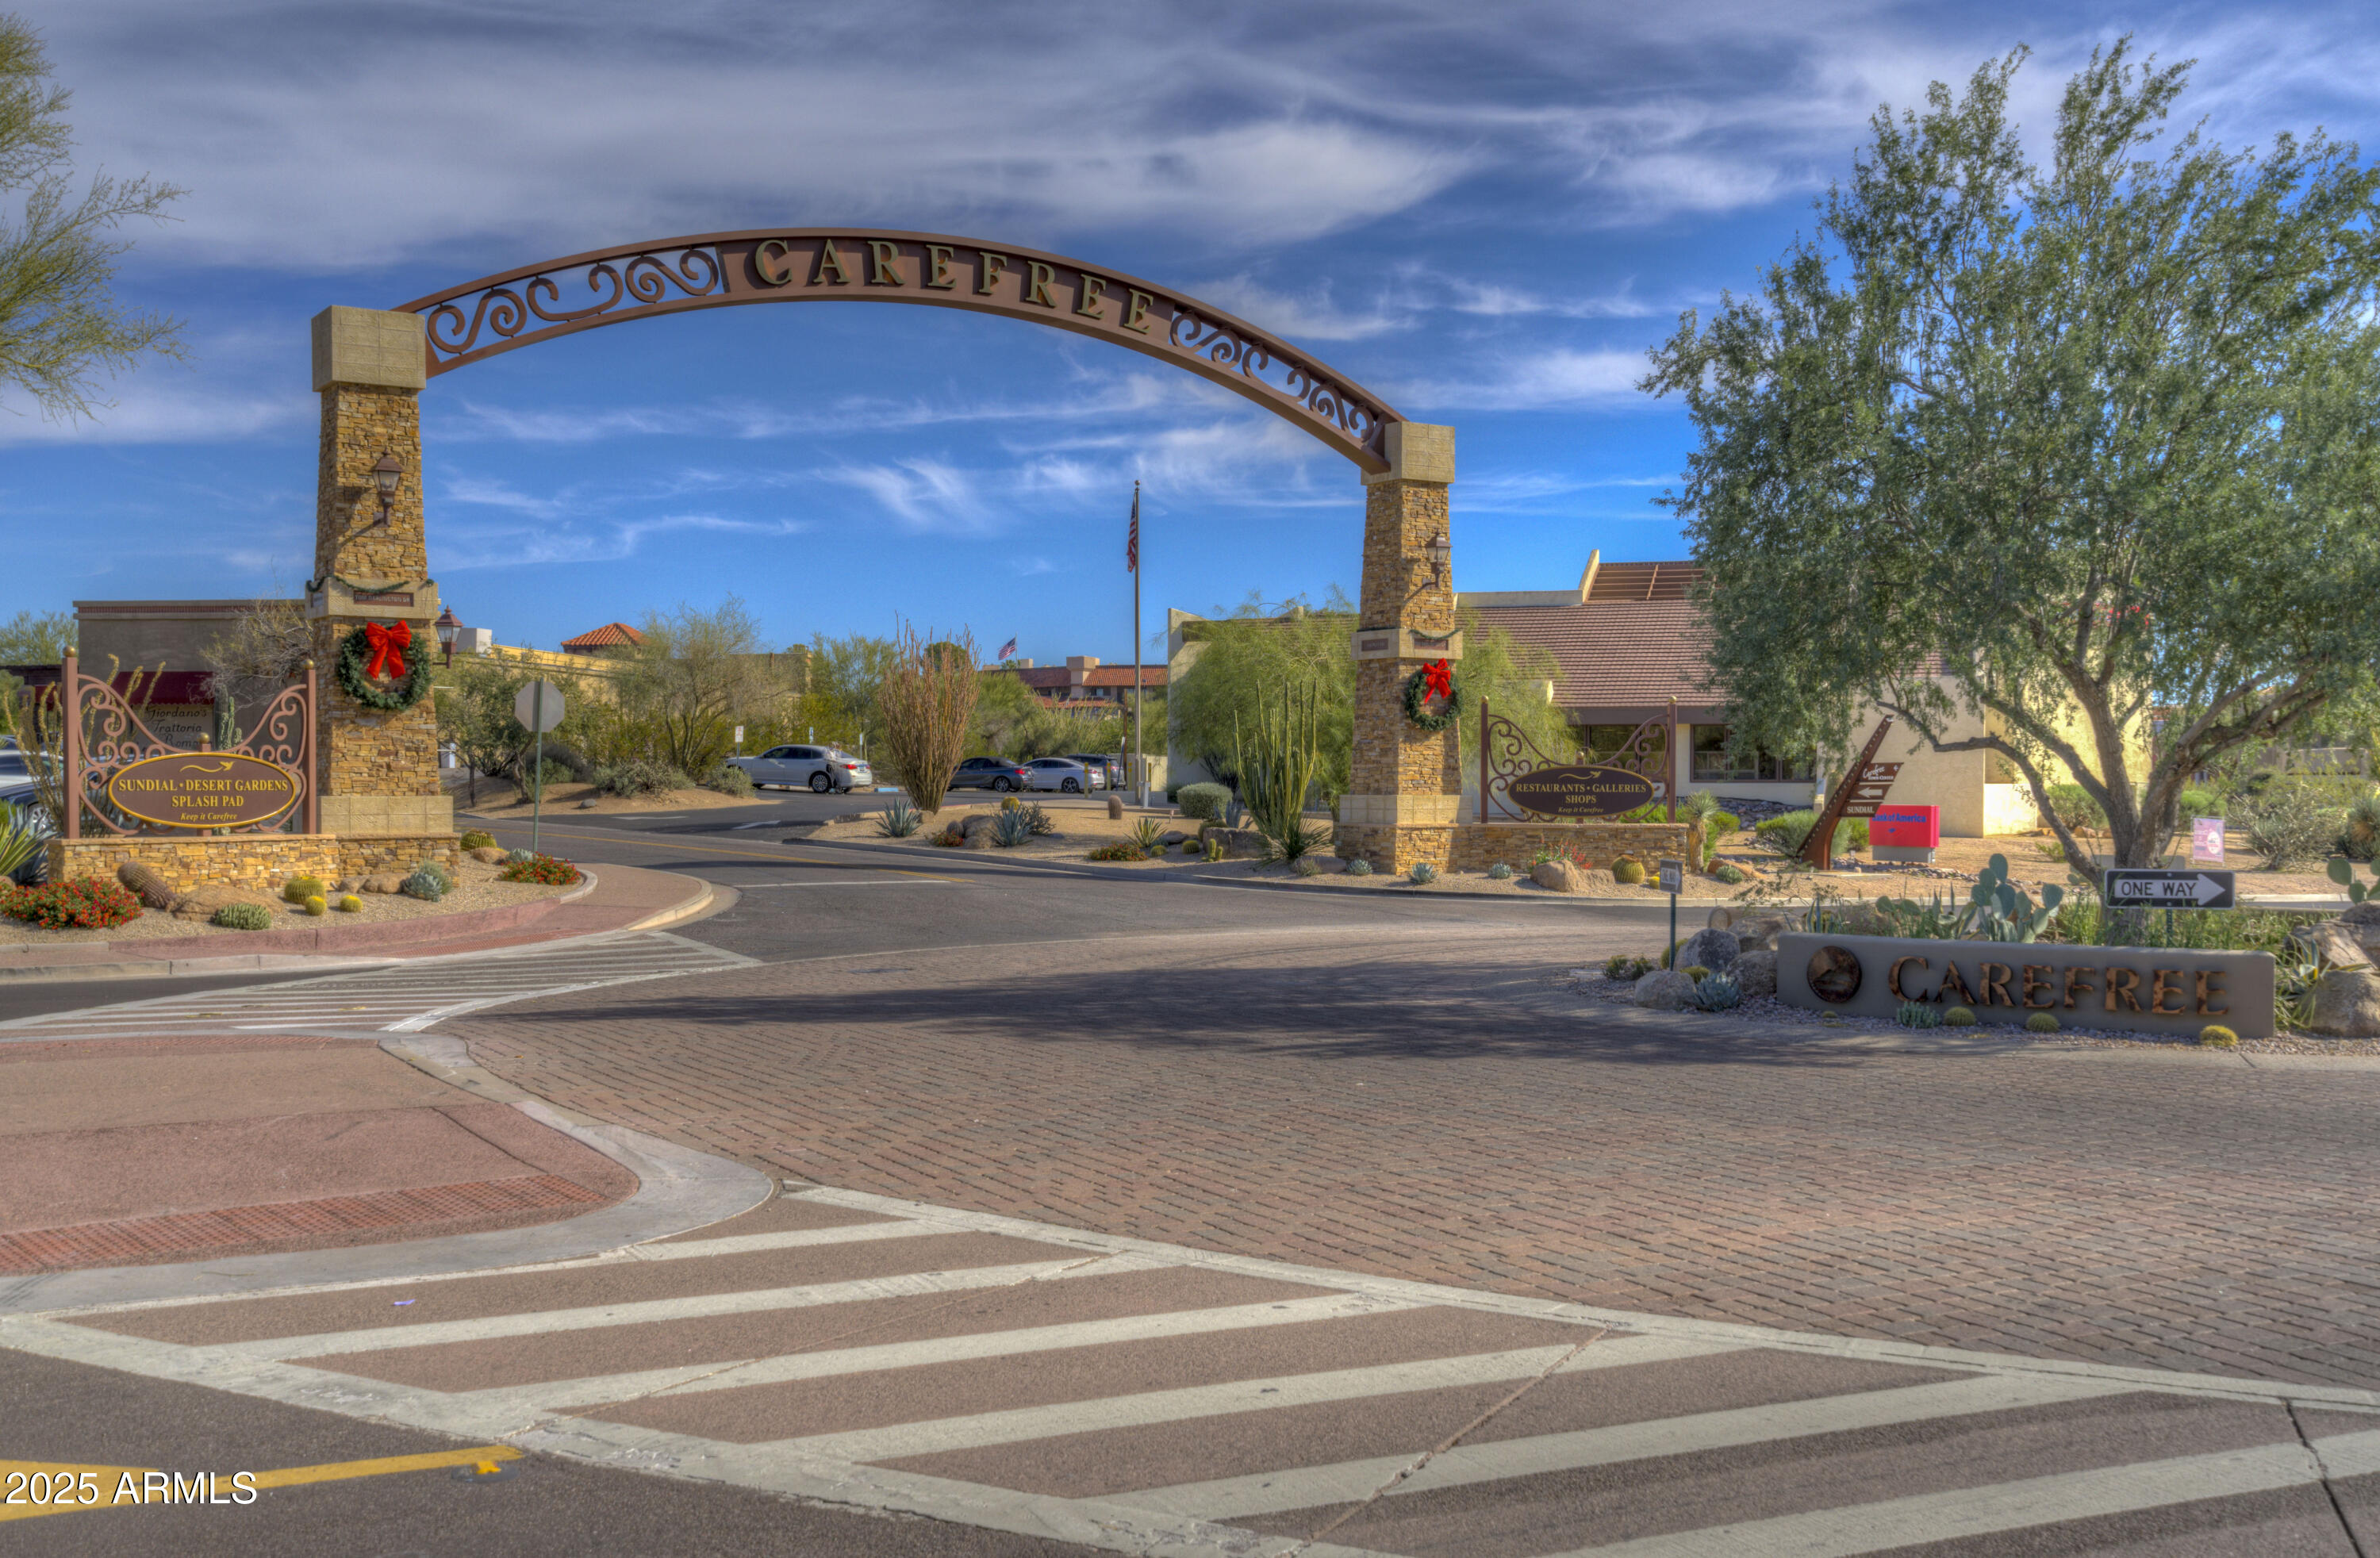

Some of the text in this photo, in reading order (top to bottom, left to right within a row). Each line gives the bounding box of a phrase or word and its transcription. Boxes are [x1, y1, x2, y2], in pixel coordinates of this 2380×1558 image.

[754, 239, 1154, 334] CAREFREE
[152, 719, 202, 733] Trattoria
[1862, 764, 1886, 778] Carefree
[119, 780, 288, 791] SUNDIAL DESERT GARDENS
[1516, 783, 1646, 793] RESTAURANTS GALLERIES
[171, 796, 244, 807] SPLASH PAD
[1565, 795, 1596, 804] SHOPS
[180, 812, 198, 822] Keep
[207, 812, 237, 821] Carefree
[1888, 812, 1895, 822] of
[1897, 813, 1926, 823] America
[2121, 881, 2197, 896] ONE WAY
[1888, 955, 2229, 1015] CAREFREE
